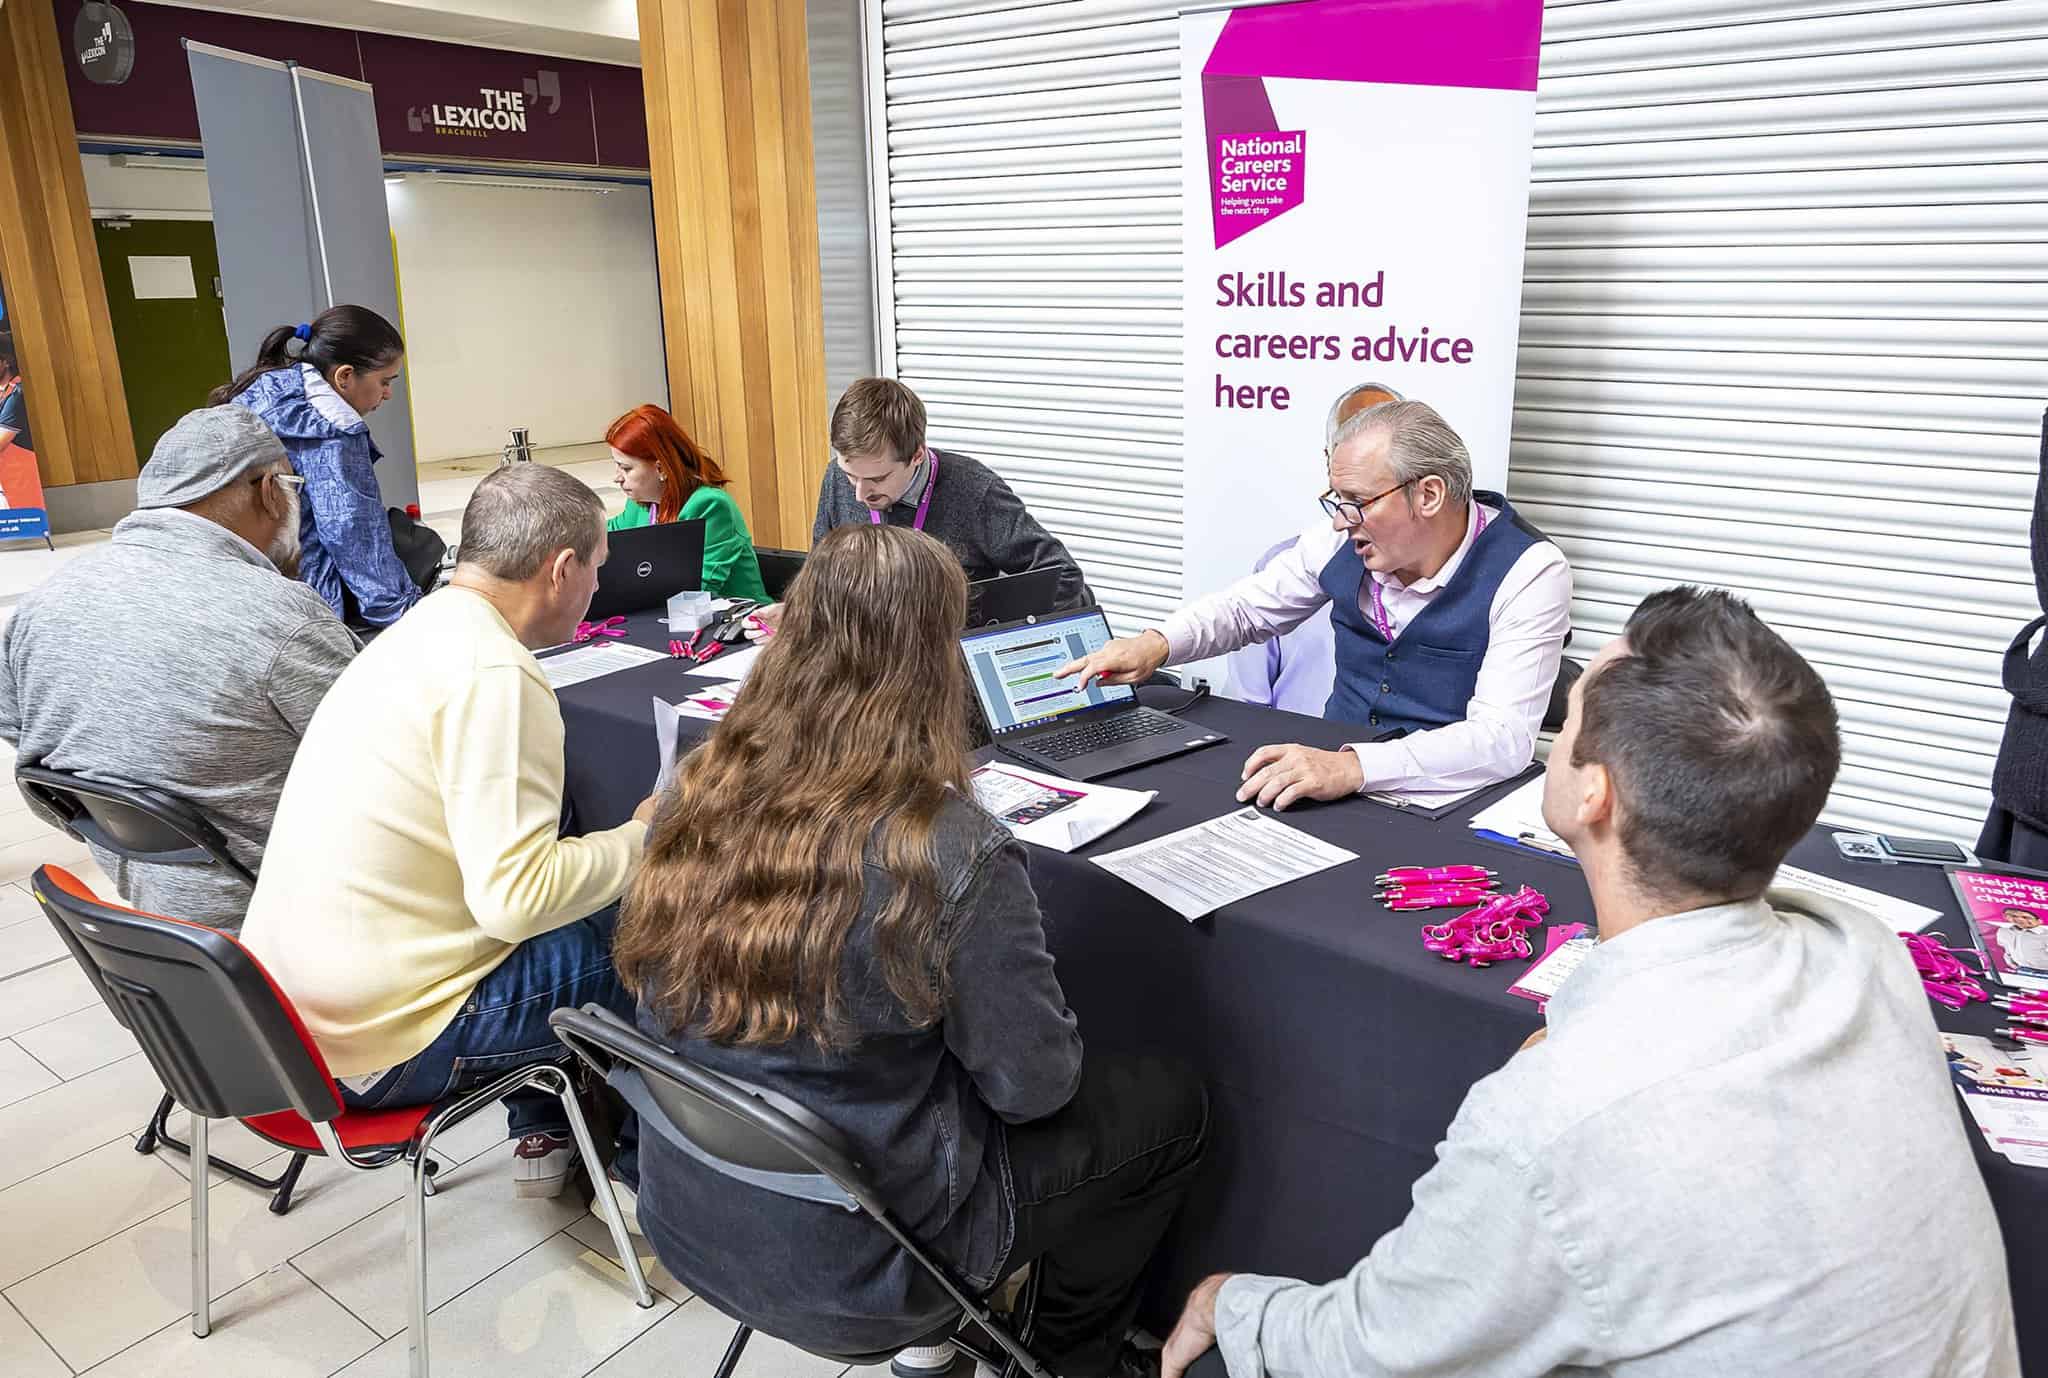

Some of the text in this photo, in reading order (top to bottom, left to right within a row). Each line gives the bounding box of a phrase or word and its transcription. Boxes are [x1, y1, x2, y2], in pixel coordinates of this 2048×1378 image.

[480, 88, 525, 112] THE
[432, 104, 527, 132] LEXICON
[435, 127, 488, 138] BRACKNELL
[1221, 134, 1302, 157] National
[1221, 157, 1292, 174] Careers
[1221, 173, 1288, 193] Service
[1221, 196, 1284, 207] Helping you take
[1221, 206, 1270, 216] the next step
[1216, 270, 1384, 307] Skills and
[1215, 325, 1474, 364] careers advice
[1215, 374, 1290, 410] here
[1968, 875, 2046, 894] Helping
[1971, 886, 2026, 898] make
